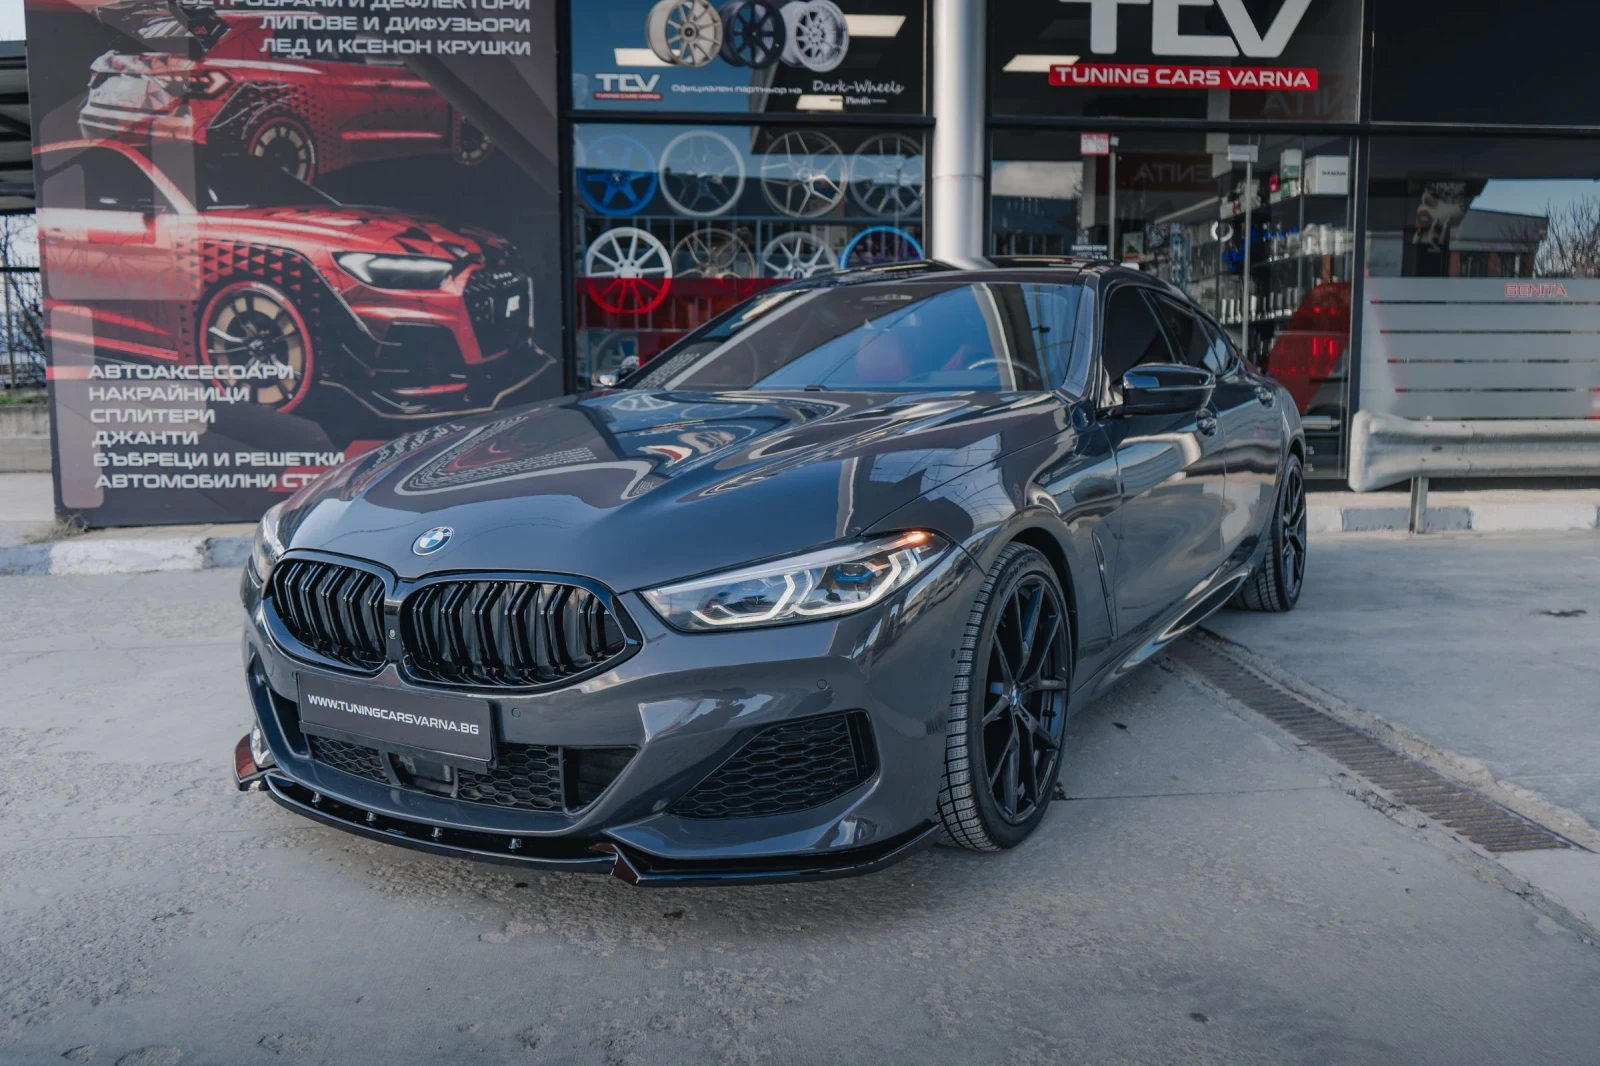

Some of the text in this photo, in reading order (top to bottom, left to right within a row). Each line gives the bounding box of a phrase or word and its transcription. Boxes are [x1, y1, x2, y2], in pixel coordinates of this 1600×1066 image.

[259, 15, 531, 34] ЛИПОВЕ И ДИФУЗЬОРИ
[1060, 0, 1313, 57] TCV
[259, 38, 531, 56] ЛЕД И КСЕНОН КРУШКИ
[594, 72, 661, 92] TCV
[1055, 66, 1311, 89] TUNING CARS VARNA
[812, 79, 905, 95] Dark-Wheels
[1504, 282, 1568, 298] BENITA
[88, 364, 295, 380] АВТОАКСЕСОАРИ
[88, 383, 250, 404] НАКРАЙНИЦИ
[90, 408, 216, 424] СПЛИТЕРИ
[91, 430, 199, 448] ДЖАНТИ
[93, 452, 345, 470] БЪБРЕЦИ И РЕШЕТКИ
[95, 473, 321, 489] АВТОМОБИЛНИ СТ
[307, 694, 479, 735] WWW.TUNINGCARSVARNA.BG
